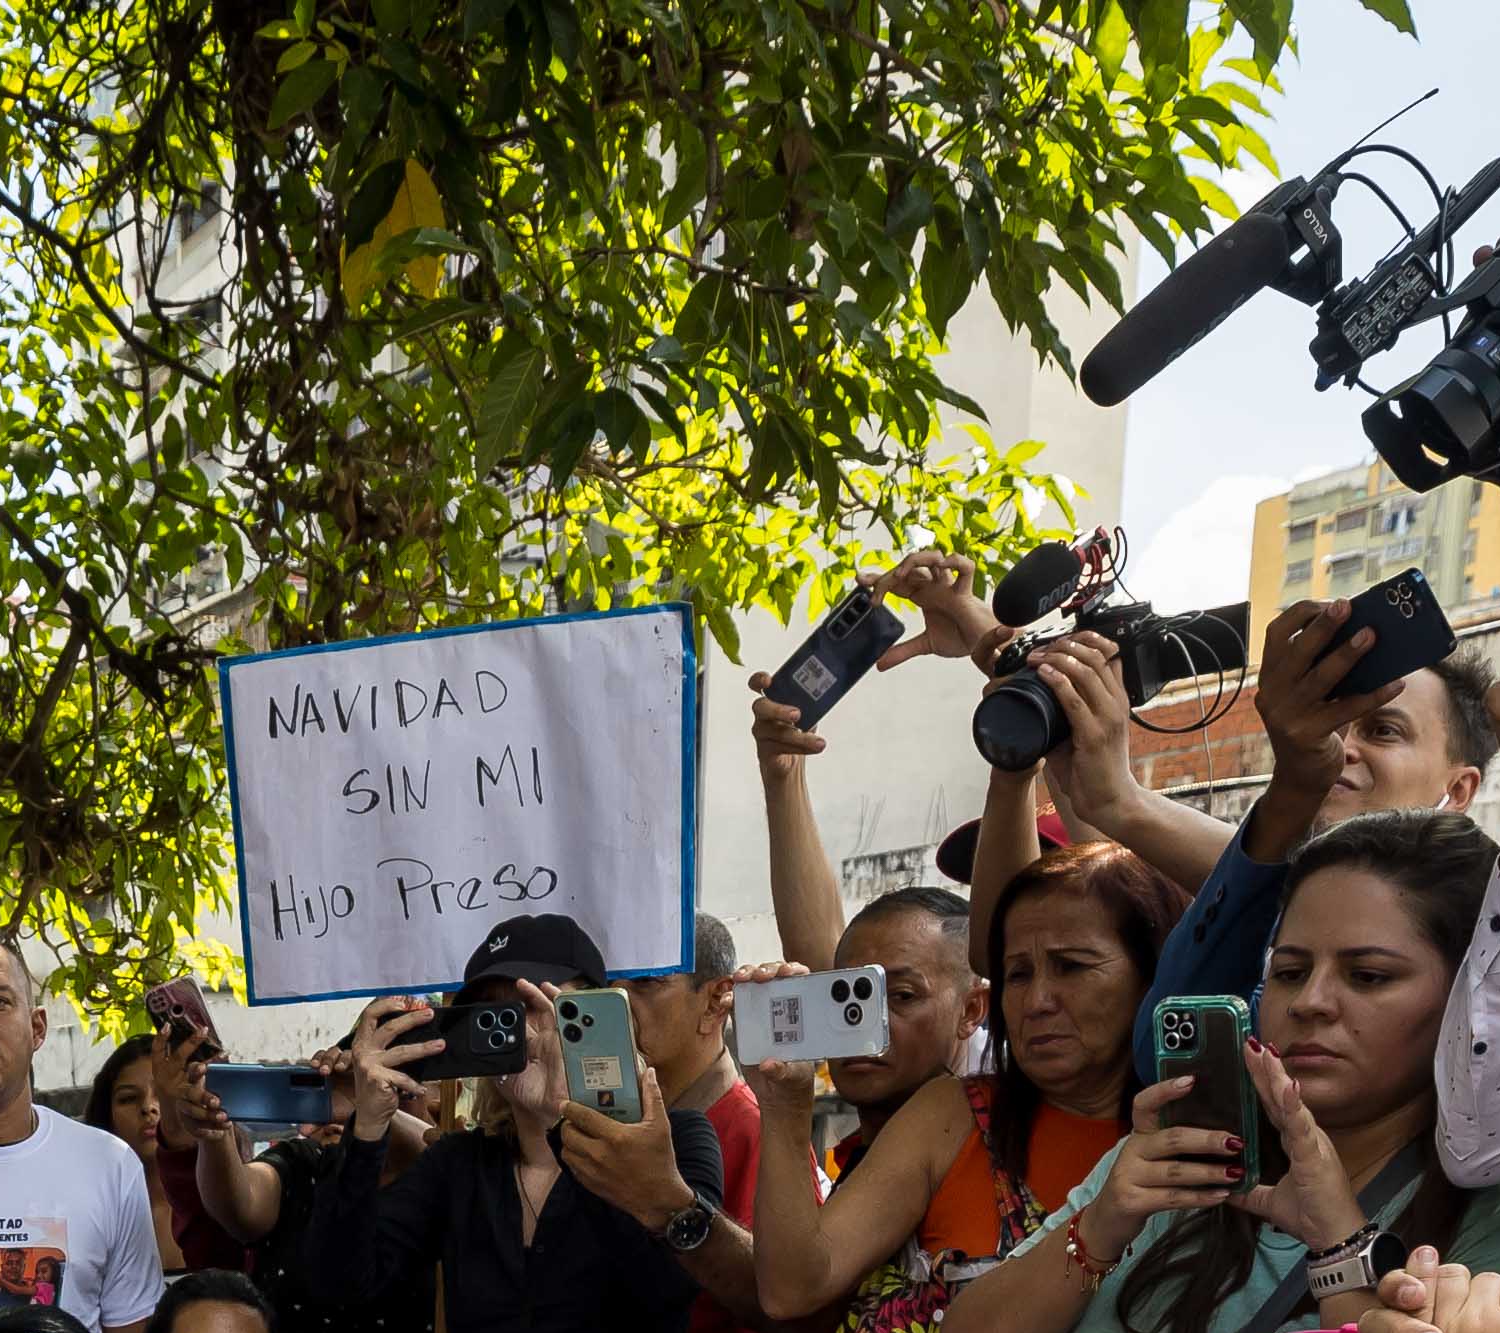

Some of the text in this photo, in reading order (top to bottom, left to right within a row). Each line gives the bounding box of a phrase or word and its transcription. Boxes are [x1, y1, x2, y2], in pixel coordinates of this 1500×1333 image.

[1303, 208, 1328, 244] VELLO
[269, 670, 507, 738] NAVIDAD
[342, 744, 543, 814] SIN MI
